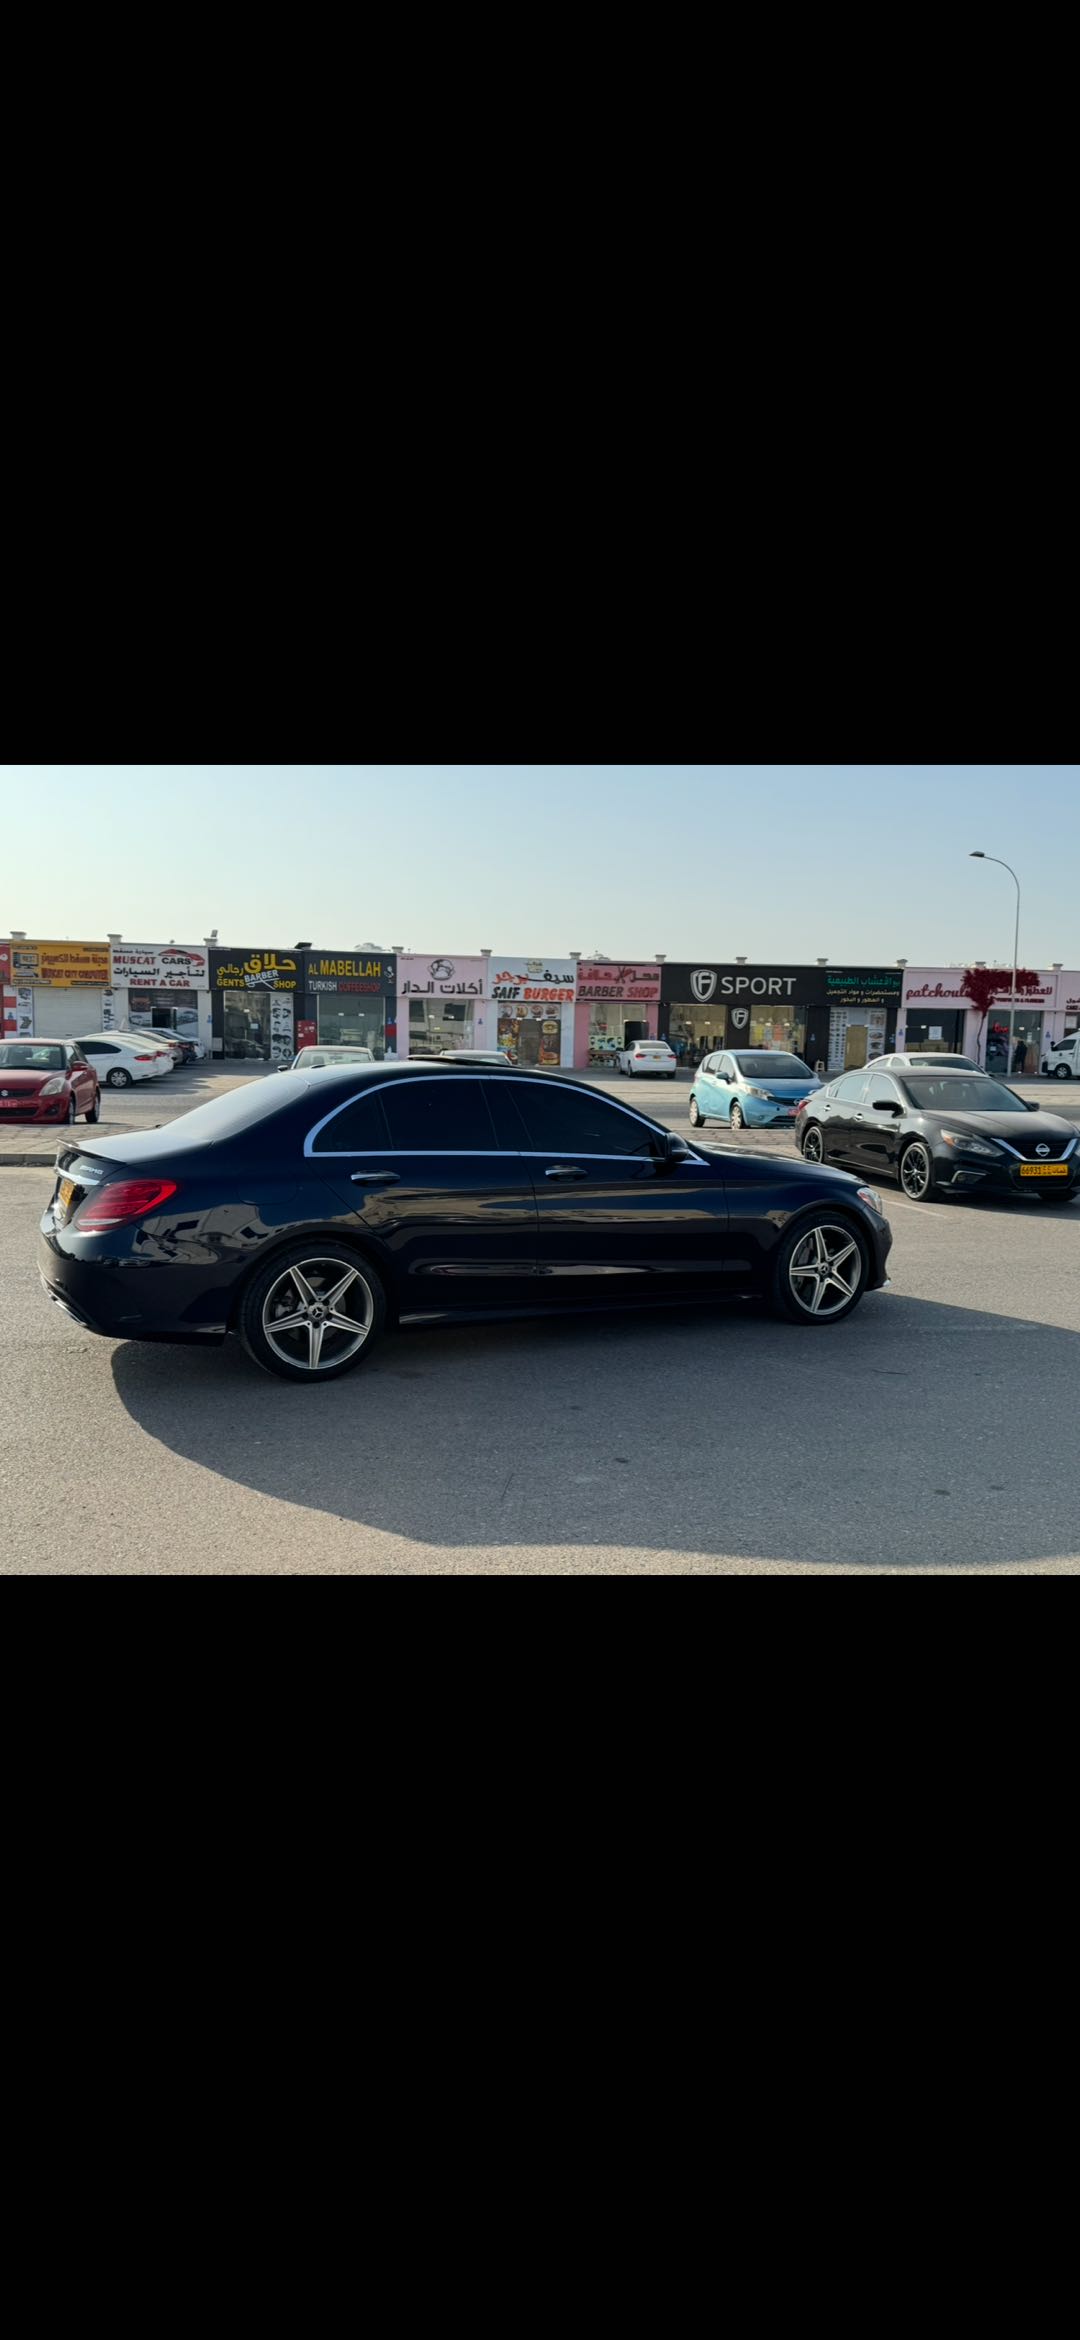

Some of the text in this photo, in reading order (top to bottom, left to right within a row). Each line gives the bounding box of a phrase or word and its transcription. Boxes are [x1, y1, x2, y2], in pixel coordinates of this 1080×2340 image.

[113, 956, 156, 965] MUSCAT
[244, 953, 297, 974] حلاق
[113, 966, 205, 979] لتأجير السيارات
[308, 960, 381, 977] AL MABELLAH
[130, 978, 157, 986] RENT
[244, 969, 280, 983] BARBER
[216, 978, 245, 987] GENTS
[273, 980, 297, 989] SHOP
[308, 981, 338, 992] TURKISH
[401, 979, 483, 995] أكلات الدار
[721, 976, 797, 996] SPORT
[492, 987, 575, 1001] SAIF BURGER
[578, 986, 659, 998] BARBER SHOP
